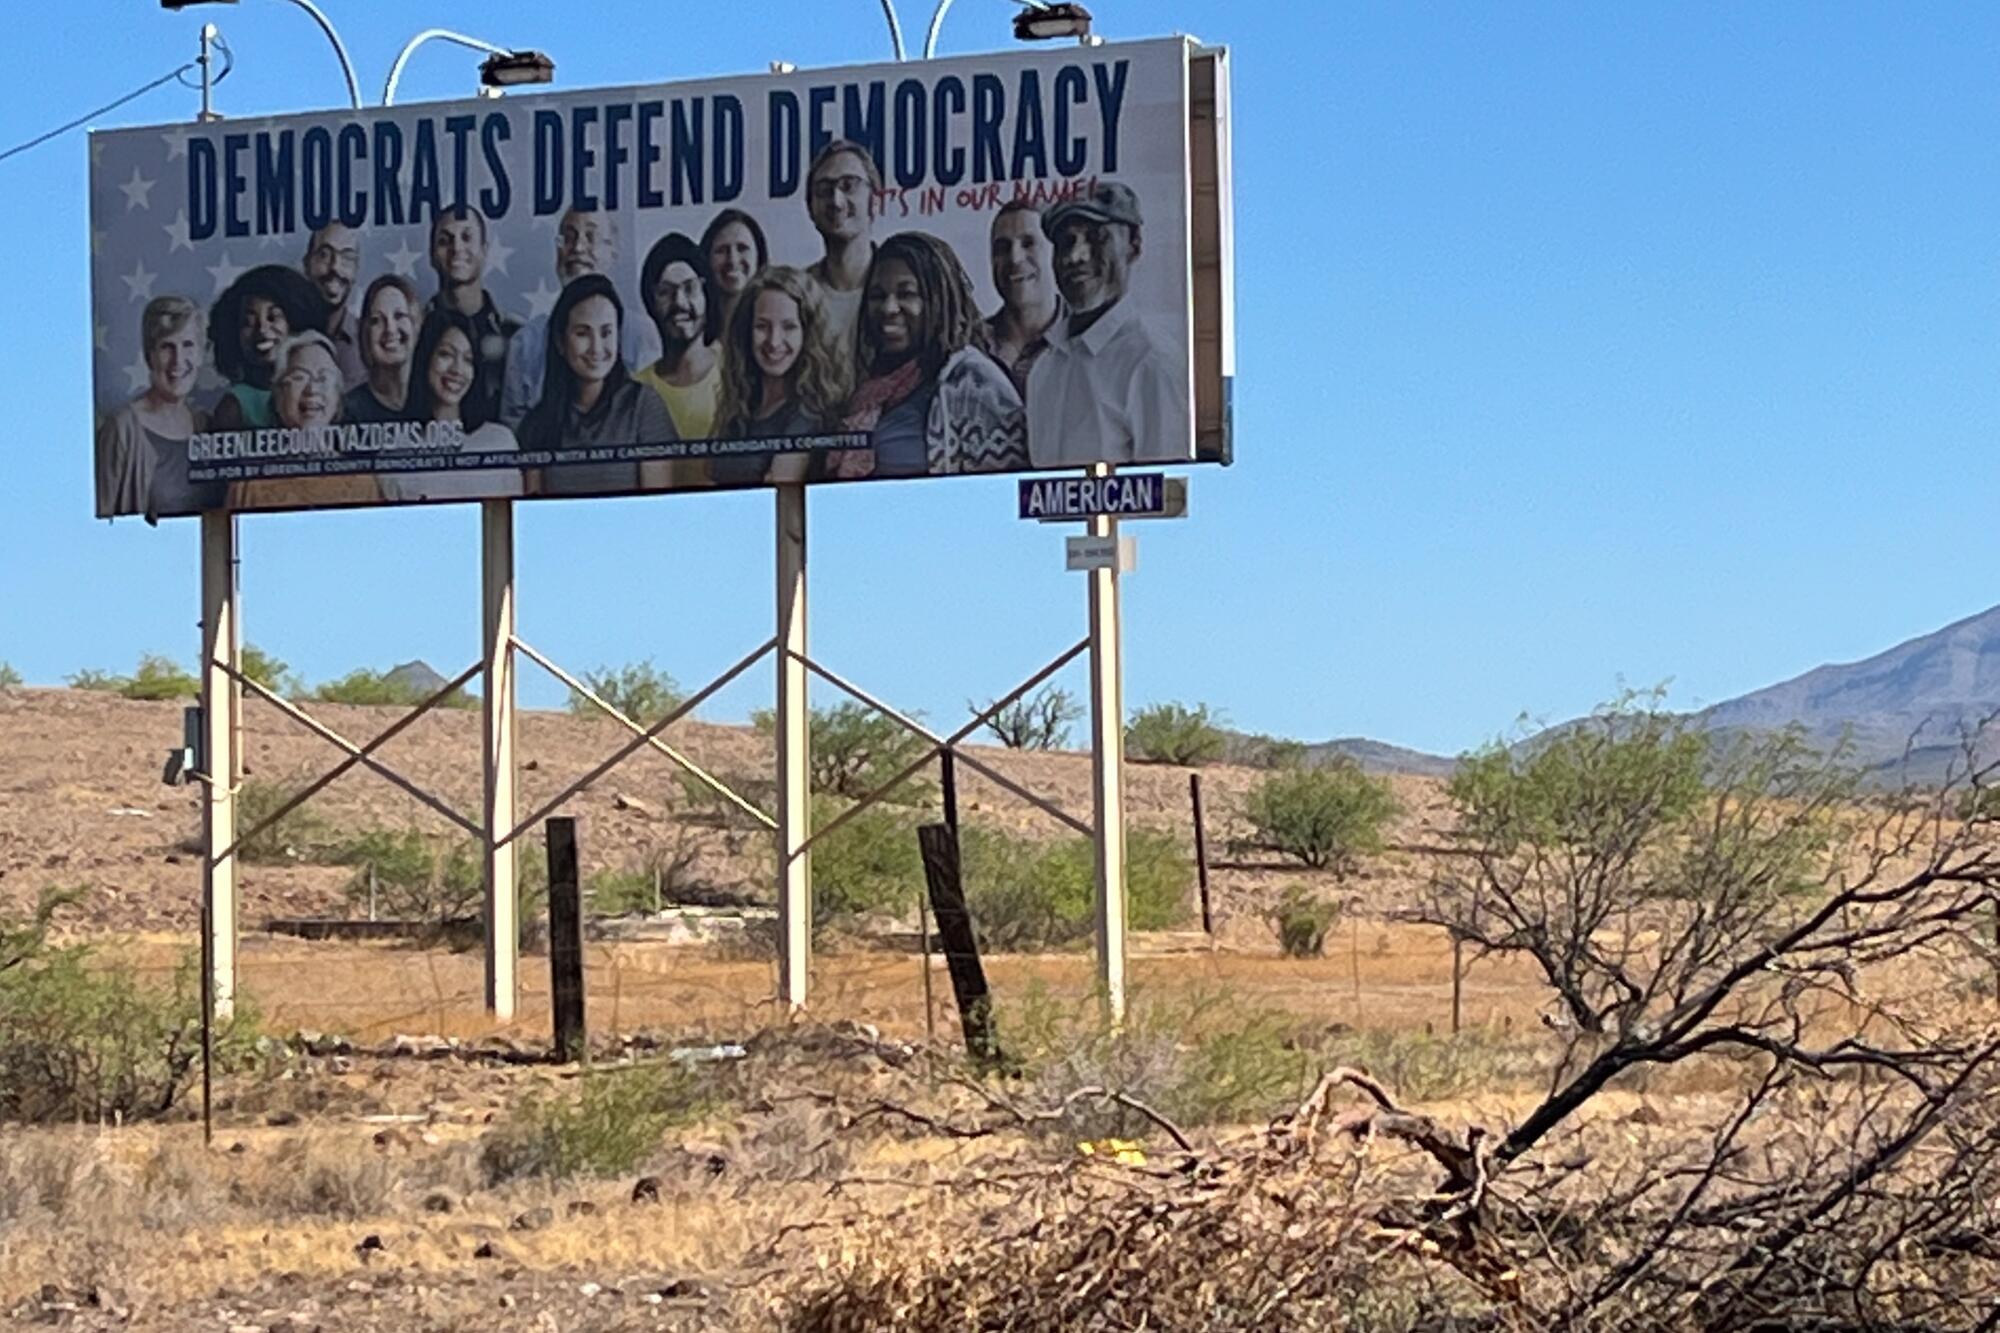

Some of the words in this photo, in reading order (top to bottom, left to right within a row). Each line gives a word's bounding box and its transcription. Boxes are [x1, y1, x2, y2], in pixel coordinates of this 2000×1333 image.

[187, 114, 512, 241] DEMOCRATS
[534, 97, 744, 216] DEFEND
[769, 60, 1130, 198] DEMOCRACY
[869, 187, 909, 218] IT'S
[921, 186, 947, 216] IN
[956, 184, 1004, 211] OUR
[1013, 176, 1097, 208] NAME!
[188, 421, 464, 460] GREENLEECOUNTYAZDEMS.ORG
[218, 466, 243, 478] FOR
[245, 465, 260, 476] BY
[262, 462, 321, 475] GREENLEE
[324, 459, 371, 472] COUNTY
[375, 455, 444, 470] DEMOCRATS
[455, 454, 480, 467] NOT
[483, 449, 552, 465] AFFILIATED
[554, 449, 587, 462] WITH
[589, 448, 614, 460] ANY
[619, 443, 687, 458] CANDIDATE
[690, 442, 709, 454] OR
[712, 438, 793, 454] CANDIDATE'S
[796, 433, 868, 449] COMMITTEE
[1028, 477, 1153, 515] AMERICAN
